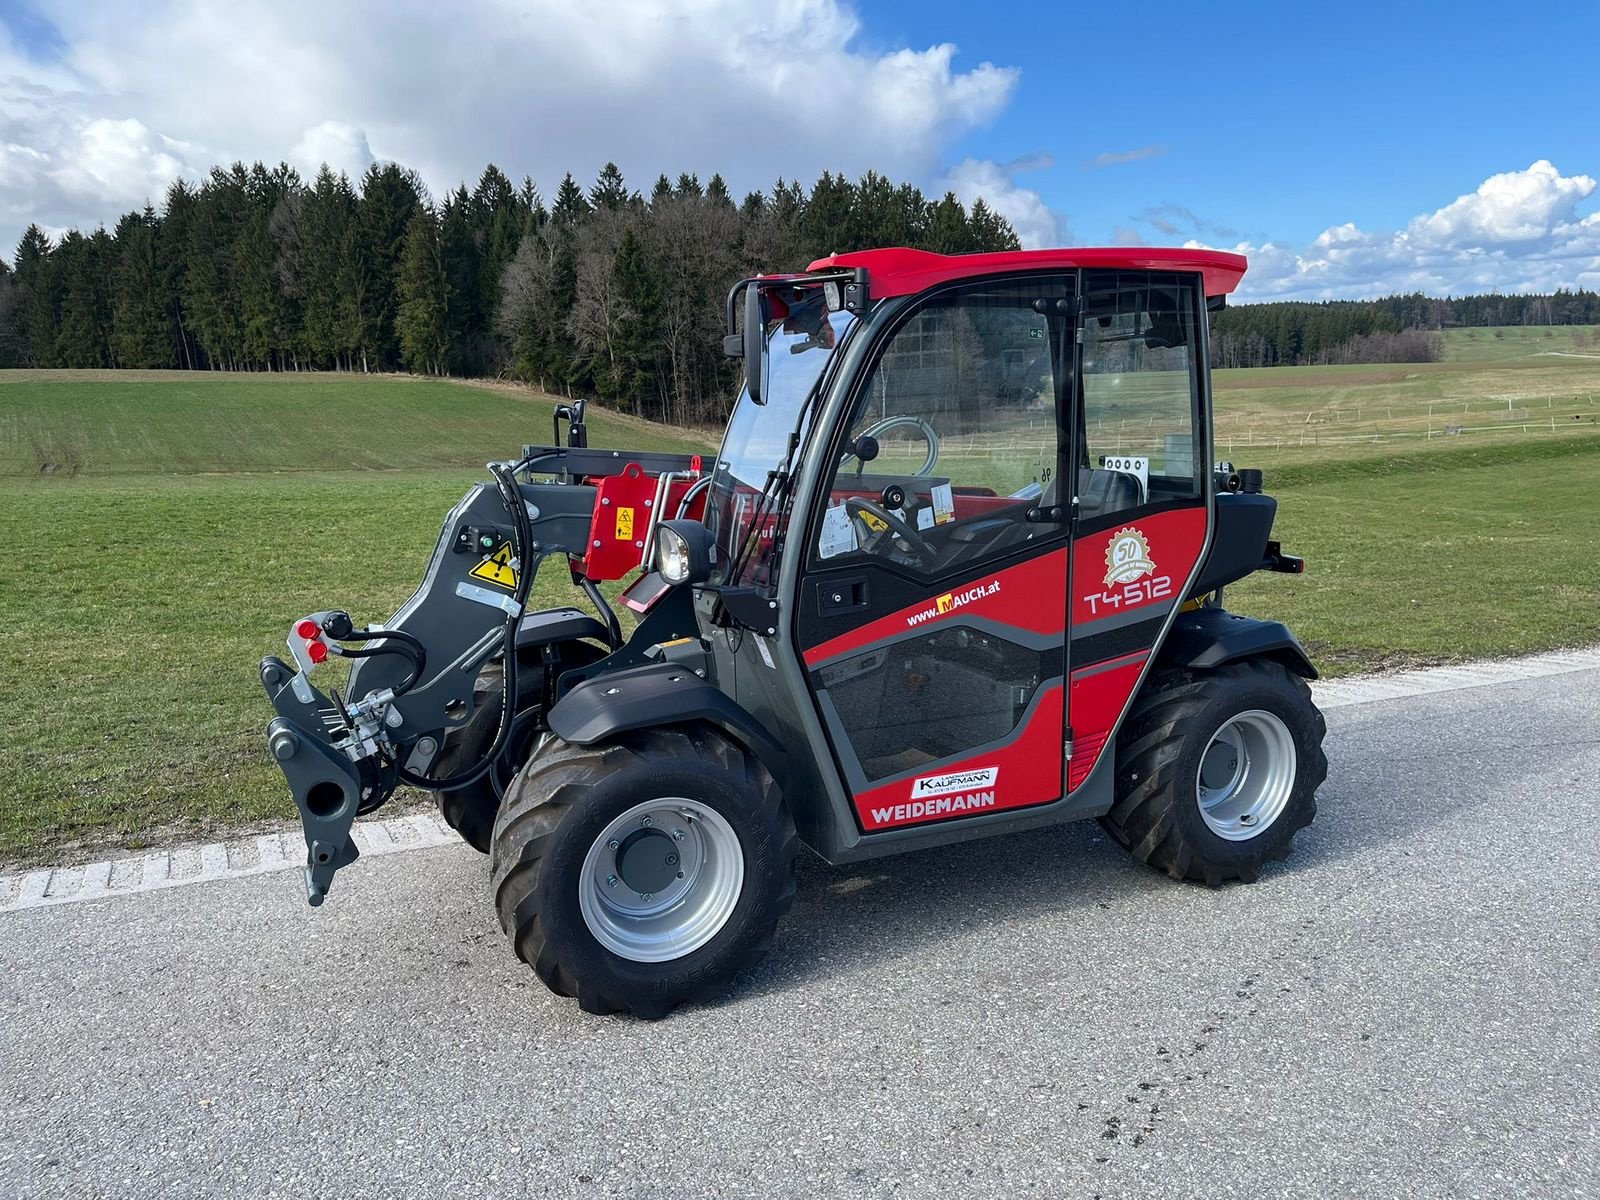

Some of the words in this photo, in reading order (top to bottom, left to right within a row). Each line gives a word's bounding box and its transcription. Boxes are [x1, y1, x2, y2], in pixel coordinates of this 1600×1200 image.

[1118, 541, 1137, 562] 50
[906, 580, 1001, 627] www.MAUCH.at
[1083, 575, 1172, 615] T4512
[920, 773, 990, 791] KAUFMANN
[871, 790, 995, 824] WEIDEMANN
